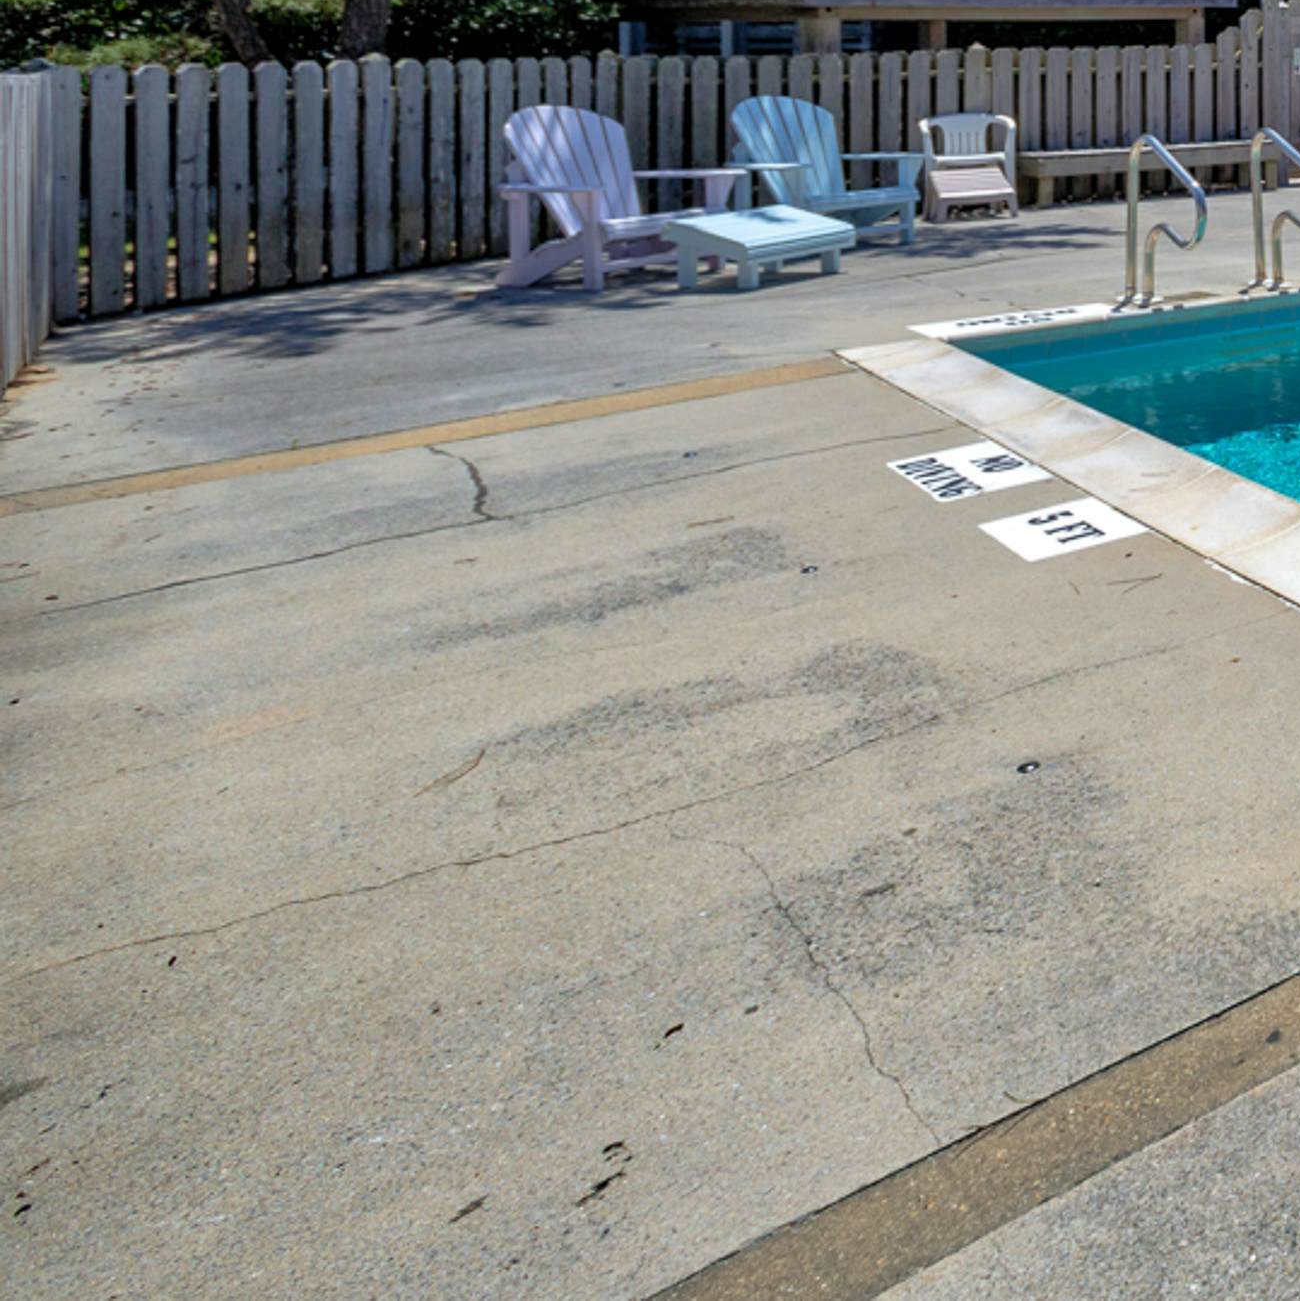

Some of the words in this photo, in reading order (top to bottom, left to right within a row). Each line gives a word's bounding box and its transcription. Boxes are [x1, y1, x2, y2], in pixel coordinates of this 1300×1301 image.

[969, 454, 1024, 473] NO
[896, 457, 983, 498] DIVING
[1028, 510, 1074, 525] 5
[1044, 520, 1106, 543] FT
